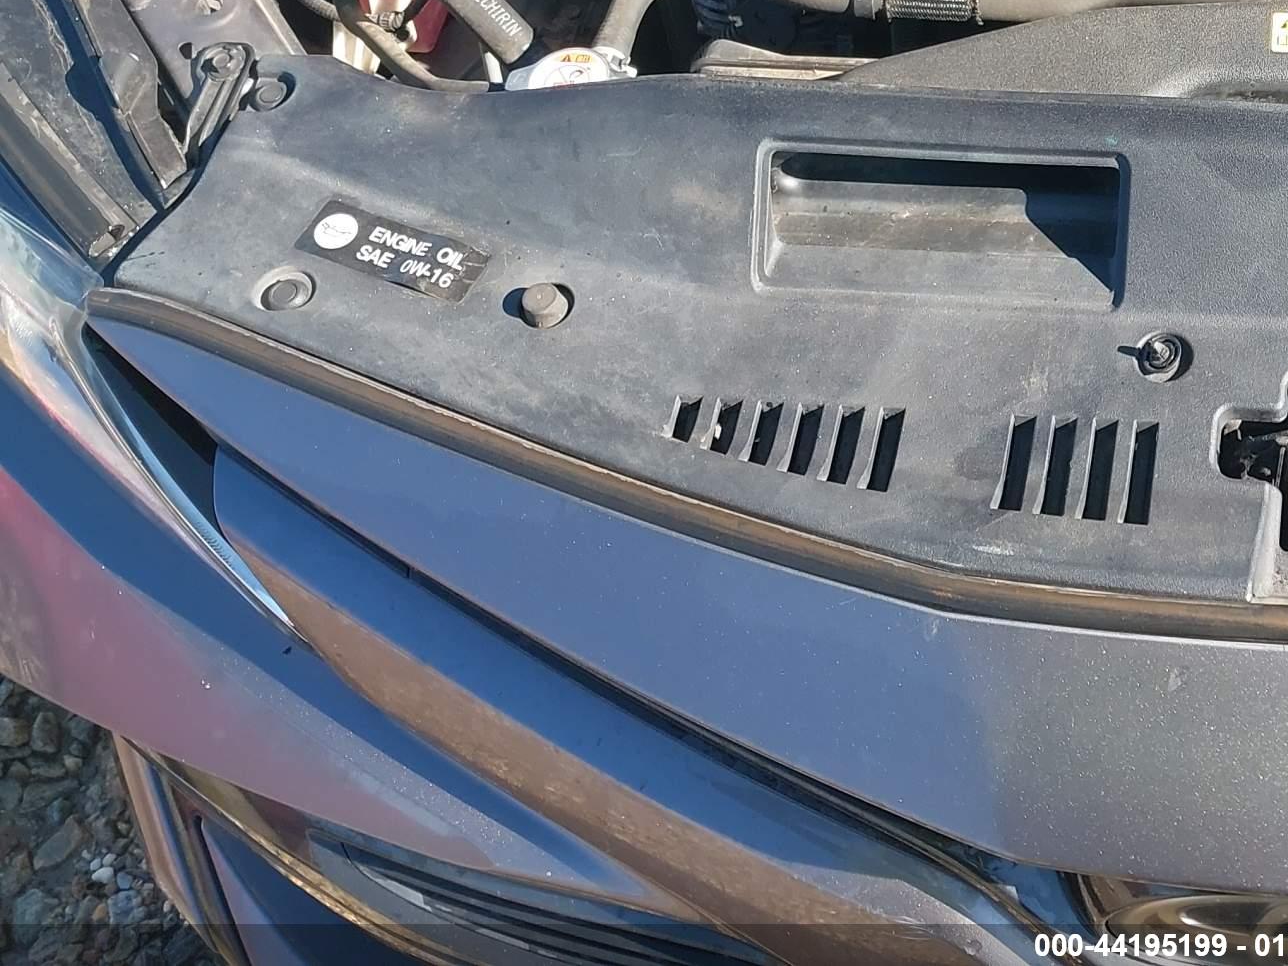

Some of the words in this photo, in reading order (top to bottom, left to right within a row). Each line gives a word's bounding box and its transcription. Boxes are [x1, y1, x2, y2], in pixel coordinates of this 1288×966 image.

[356, 245, 395, 268] SAE
[400, 259, 454, 288] 0W-16
[368, 225, 432, 256] ENGINE
[436, 246, 464, 270] OIL
